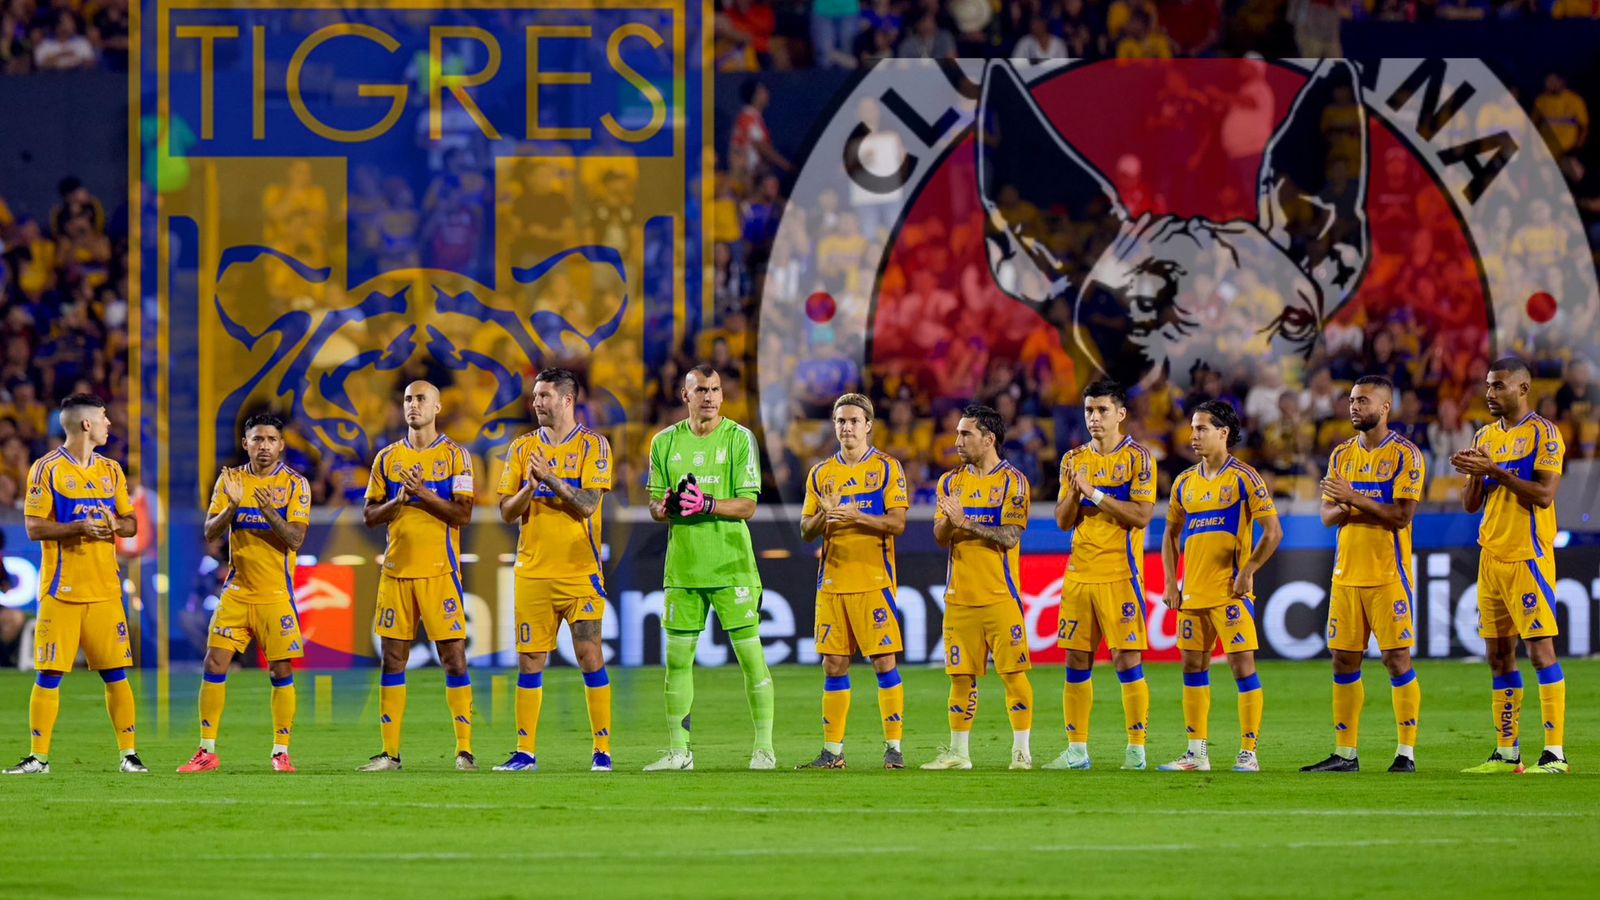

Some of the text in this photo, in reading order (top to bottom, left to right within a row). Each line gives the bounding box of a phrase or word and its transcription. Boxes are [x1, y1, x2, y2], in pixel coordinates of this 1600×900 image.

[1195, 516, 1225, 528] CEMEX
[378, 607, 396, 629] 19
[1058, 617, 1079, 640] 27
